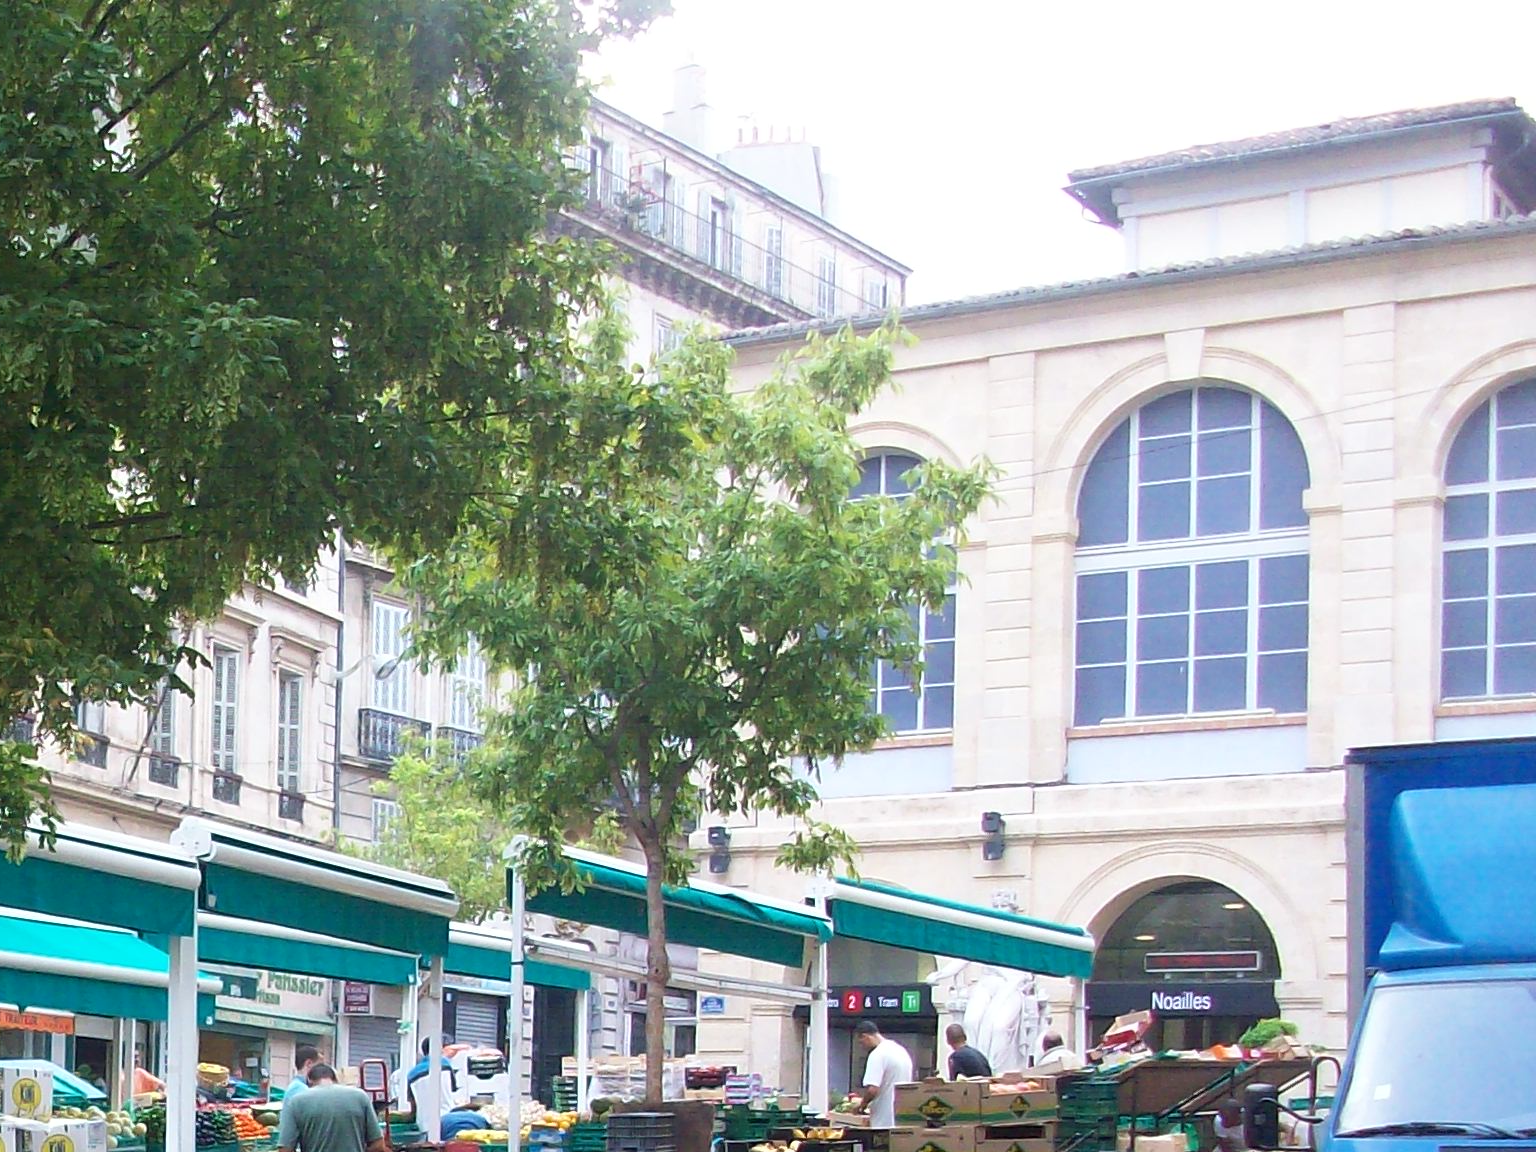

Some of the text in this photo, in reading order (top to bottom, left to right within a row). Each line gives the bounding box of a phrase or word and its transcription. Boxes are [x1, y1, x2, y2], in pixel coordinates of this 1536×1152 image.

[848, 994, 857, 1010] 2
[864, 996, 872, 1008] &
[877, 996, 899, 1008] Tram
[1151, 990, 1212, 1010] Noailles
